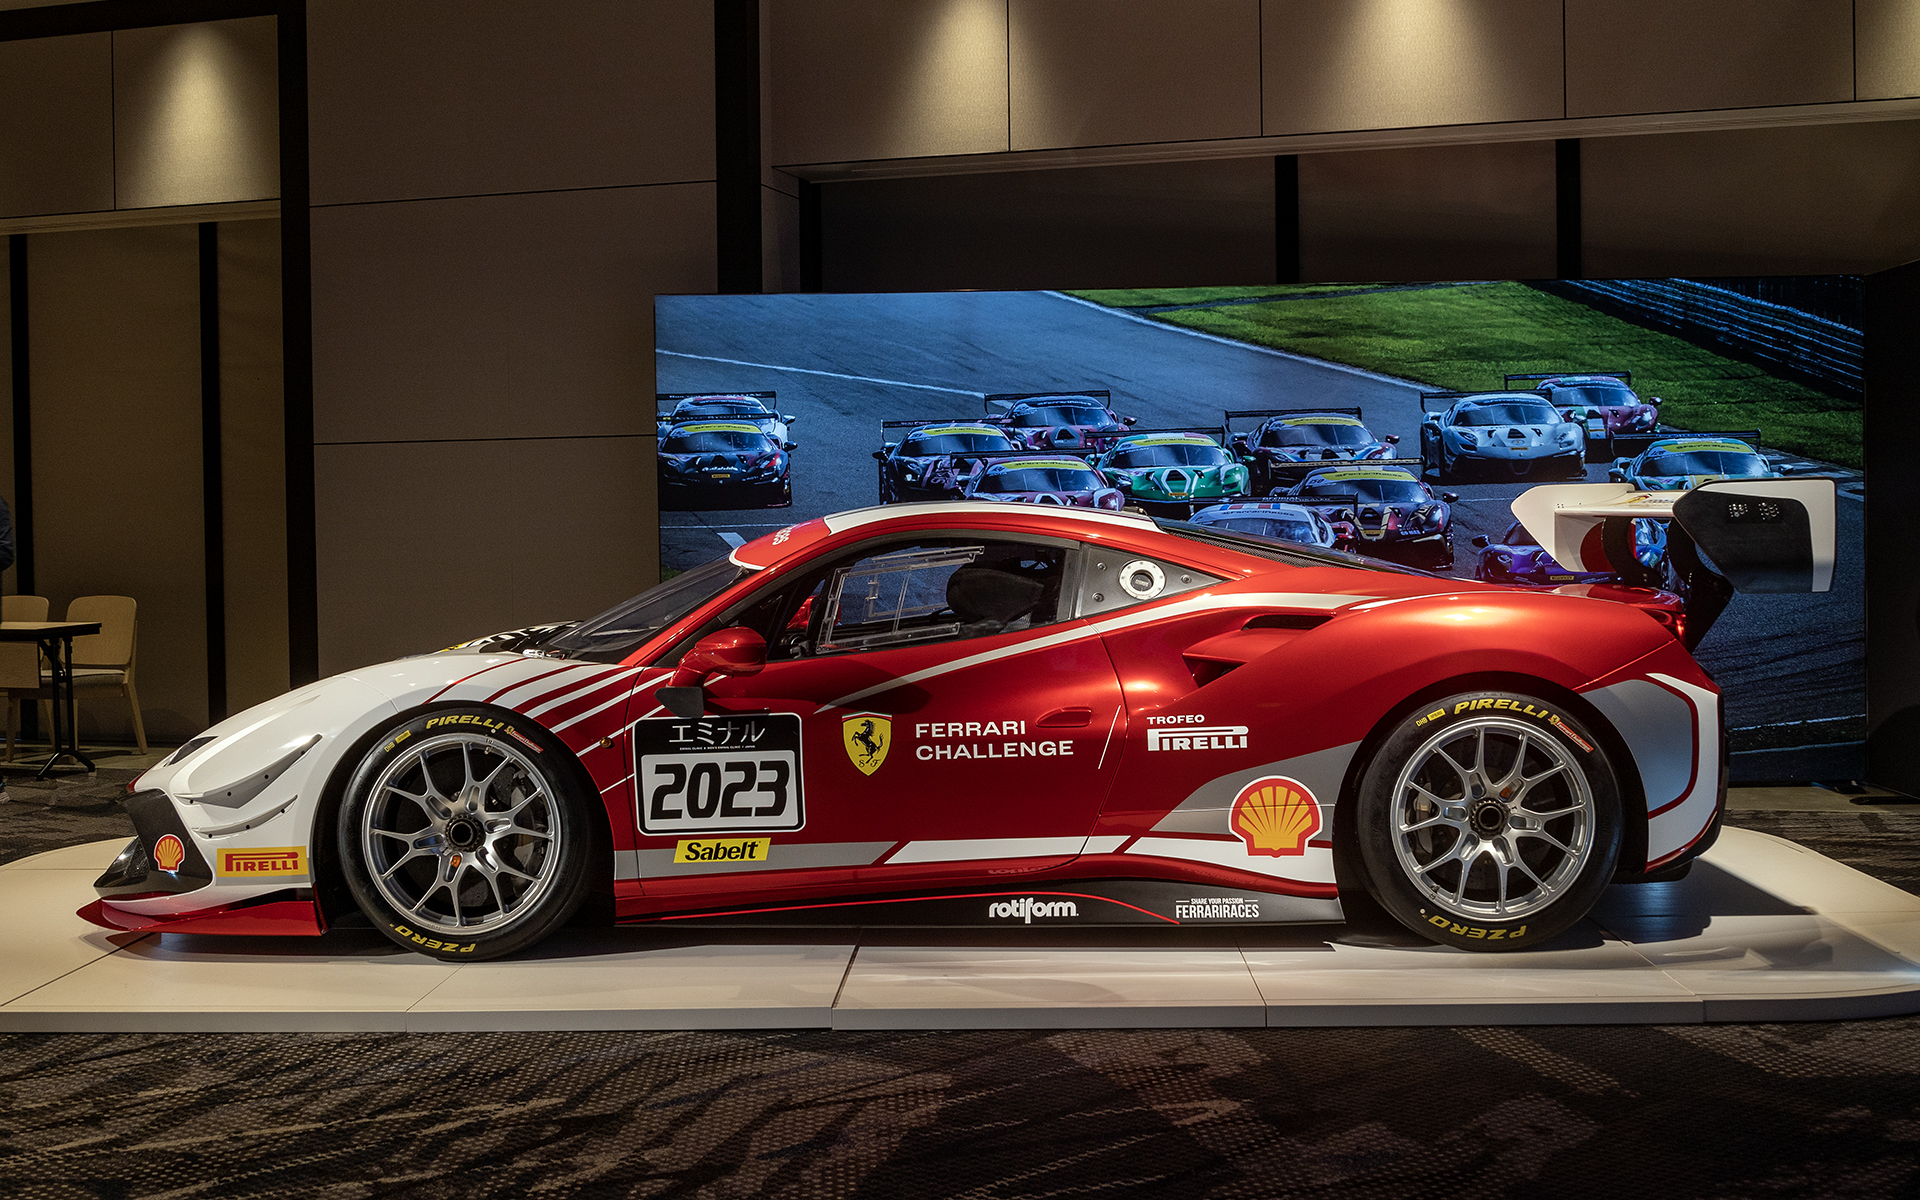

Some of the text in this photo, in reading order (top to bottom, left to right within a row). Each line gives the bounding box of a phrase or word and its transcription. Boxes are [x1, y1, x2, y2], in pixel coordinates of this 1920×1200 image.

[1453, 698, 1549, 719] PIRELLI
[425, 715, 505, 730] PIRELLI
[915, 720, 1025, 738] FERRARI
[1146, 714, 1205, 725] TROFEO
[668, 720, 766, 745] エミナル
[1146, 725, 1249, 752] PIRELLI
[915, 740, 1074, 761] CHALLENGE
[650, 760, 790, 820] 2023
[685, 841, 759, 861] Sabelt
[225, 851, 299, 872] PIRELLI
[1190, 897, 1244, 905] SHARE YOUR PASSION
[1175, 904, 1260, 919] FERRARIRACES
